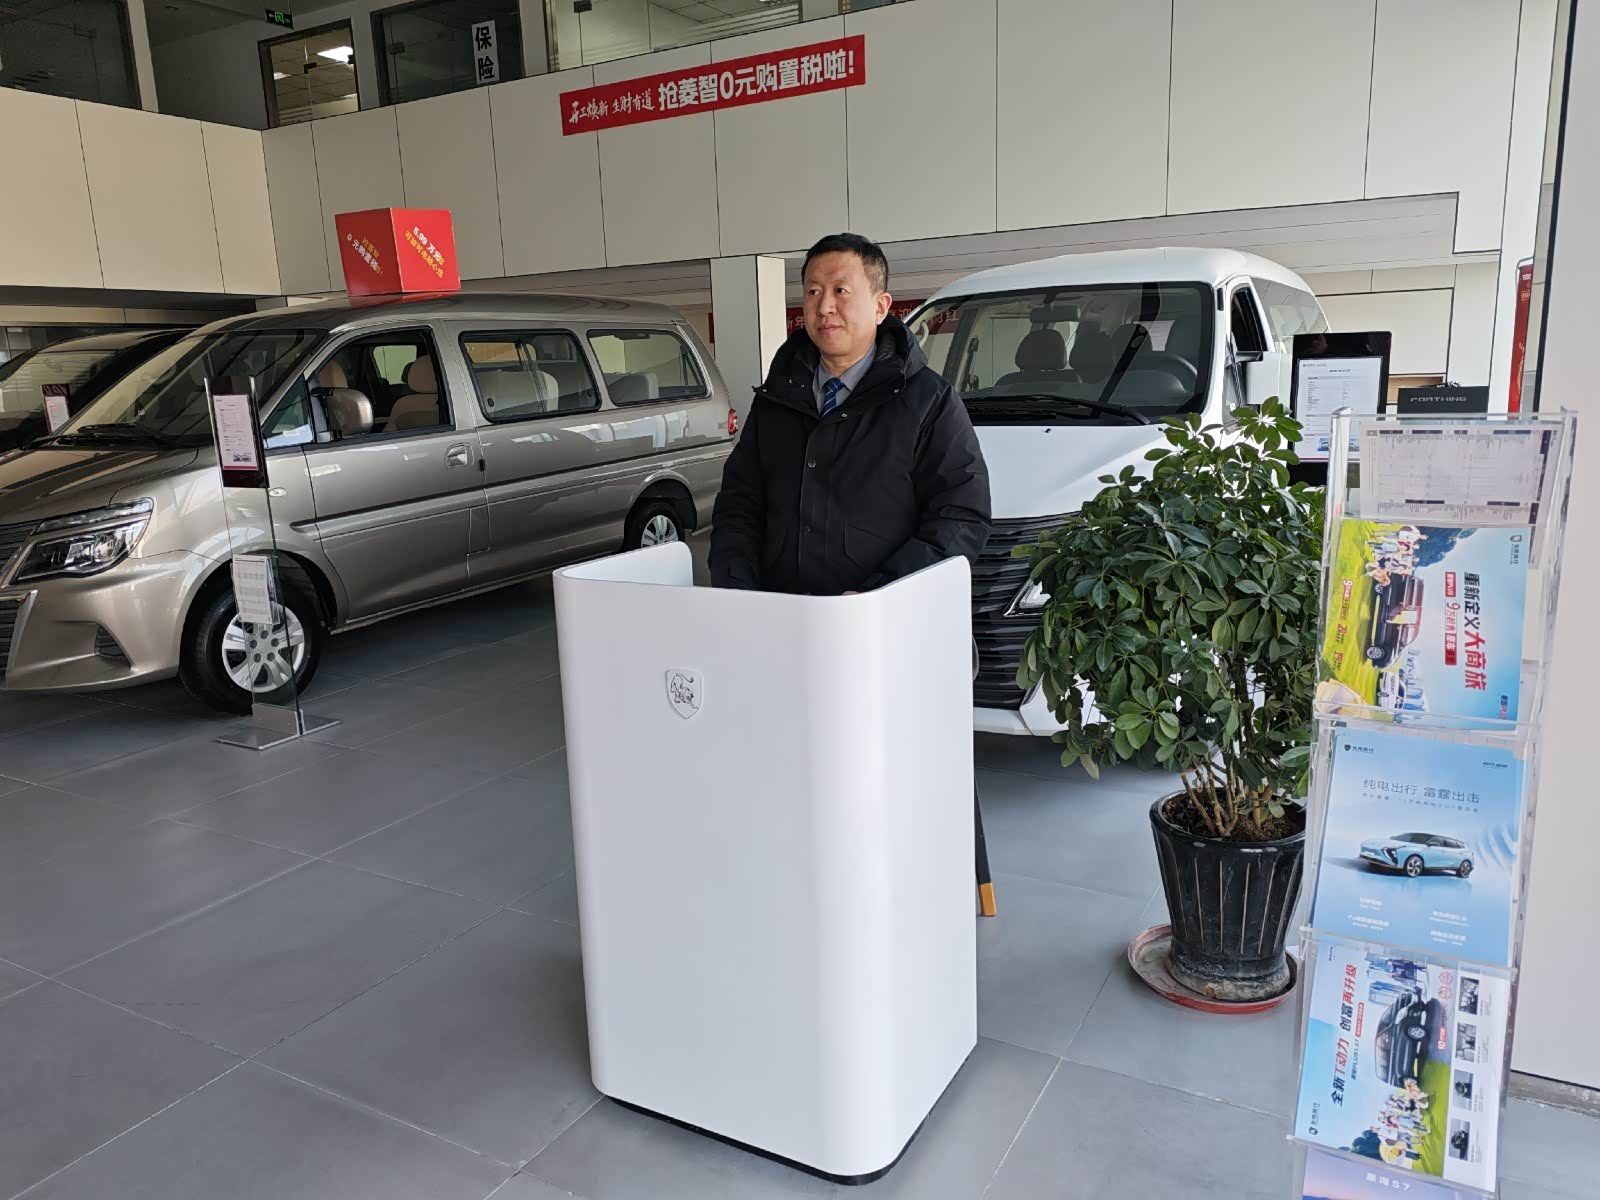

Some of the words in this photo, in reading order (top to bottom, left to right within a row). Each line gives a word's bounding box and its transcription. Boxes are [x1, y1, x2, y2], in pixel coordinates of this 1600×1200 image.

[474, 25, 496, 81] 保险
[612, 87, 655, 114] 生财有道
[1464, 571, 1487, 691] 重新定义大商旅
[1363, 778, 1418, 796] 纯电出行
[1423, 786, 1480, 804] 雷霆出击
[1339, 964, 1358, 1032] 创富再升级
[1330, 1038, 1350, 1107] 全新T动力
